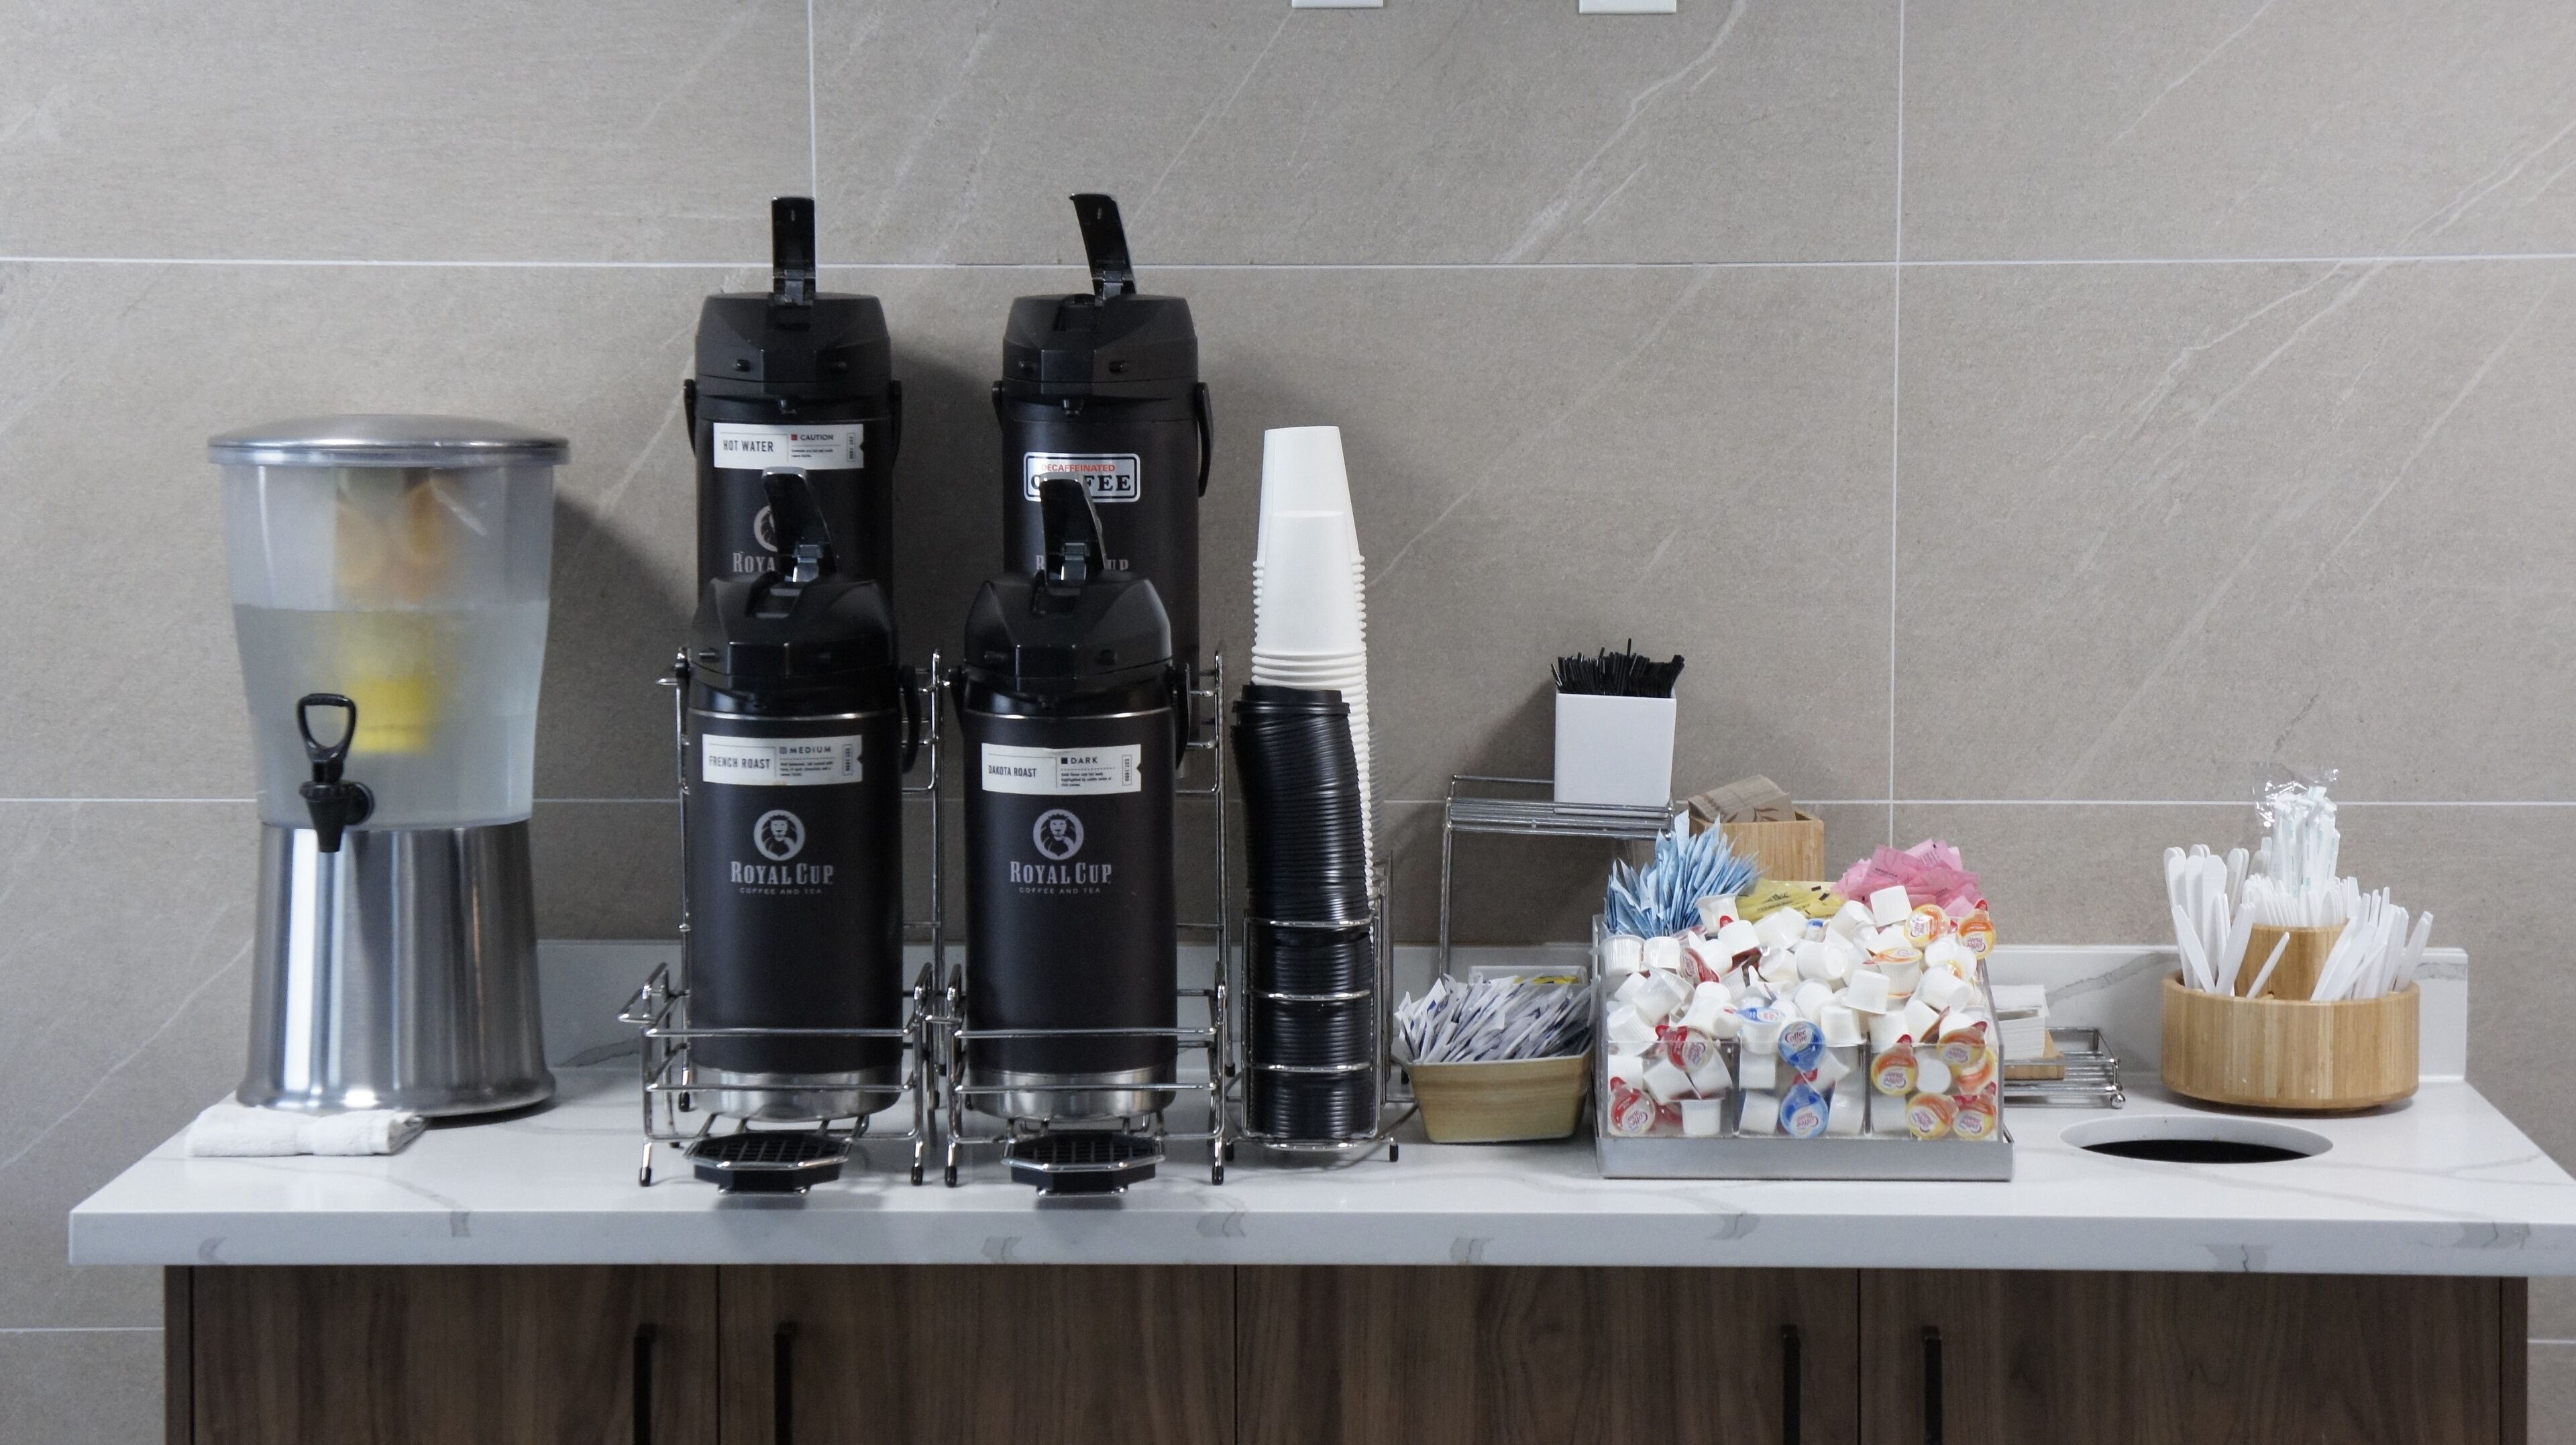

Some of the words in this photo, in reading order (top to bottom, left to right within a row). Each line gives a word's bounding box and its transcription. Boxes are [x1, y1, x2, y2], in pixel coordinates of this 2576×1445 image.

[722, 439, 738, 451] HOT
[742, 440, 773, 452] WATER
[733, 551, 775, 572] ROYA
[790, 746, 831, 754] MEDIUM
[708, 755, 737, 768] FRENCH
[741, 758, 771, 769] ROAST
[988, 765, 1012, 777] DAKOTA
[1014, 767, 1036, 778] ROAST
[1785, 1030, 1807, 1043] Coffee
